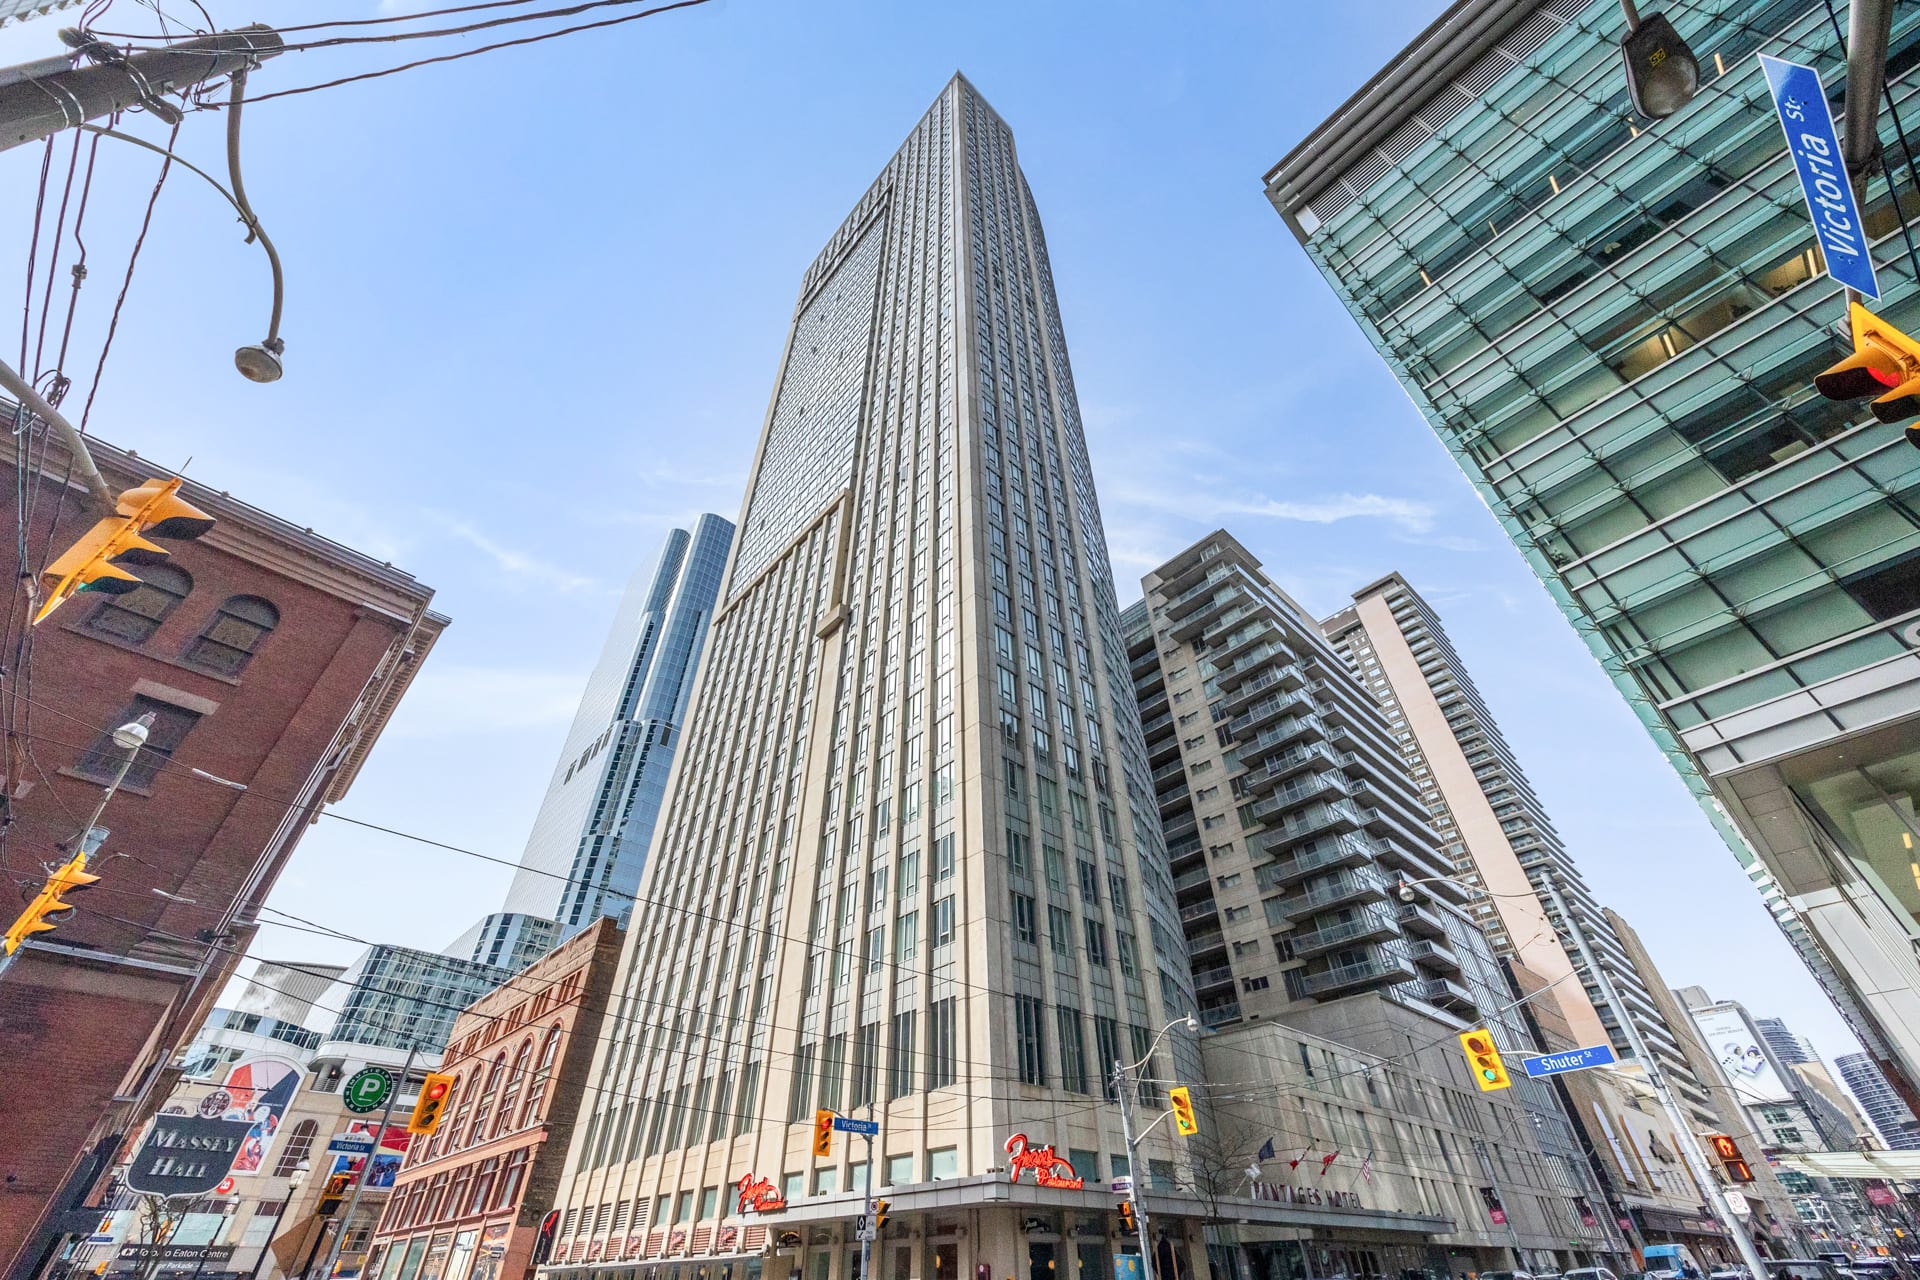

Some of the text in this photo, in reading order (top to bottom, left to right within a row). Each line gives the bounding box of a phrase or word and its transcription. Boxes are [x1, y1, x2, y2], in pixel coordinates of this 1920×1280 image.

[1785, 95, 1858, 256] Victoria St
[1541, 1050, 1593, 1071] Shuter St
[358, 1078, 380, 1097] P
[841, 1119, 867, 1132] Victoria
[336, 1141, 359, 1151] Victoria
[1325, 1189, 1364, 1209] HOTEL
[173, 1248, 197, 1257] Eaton
